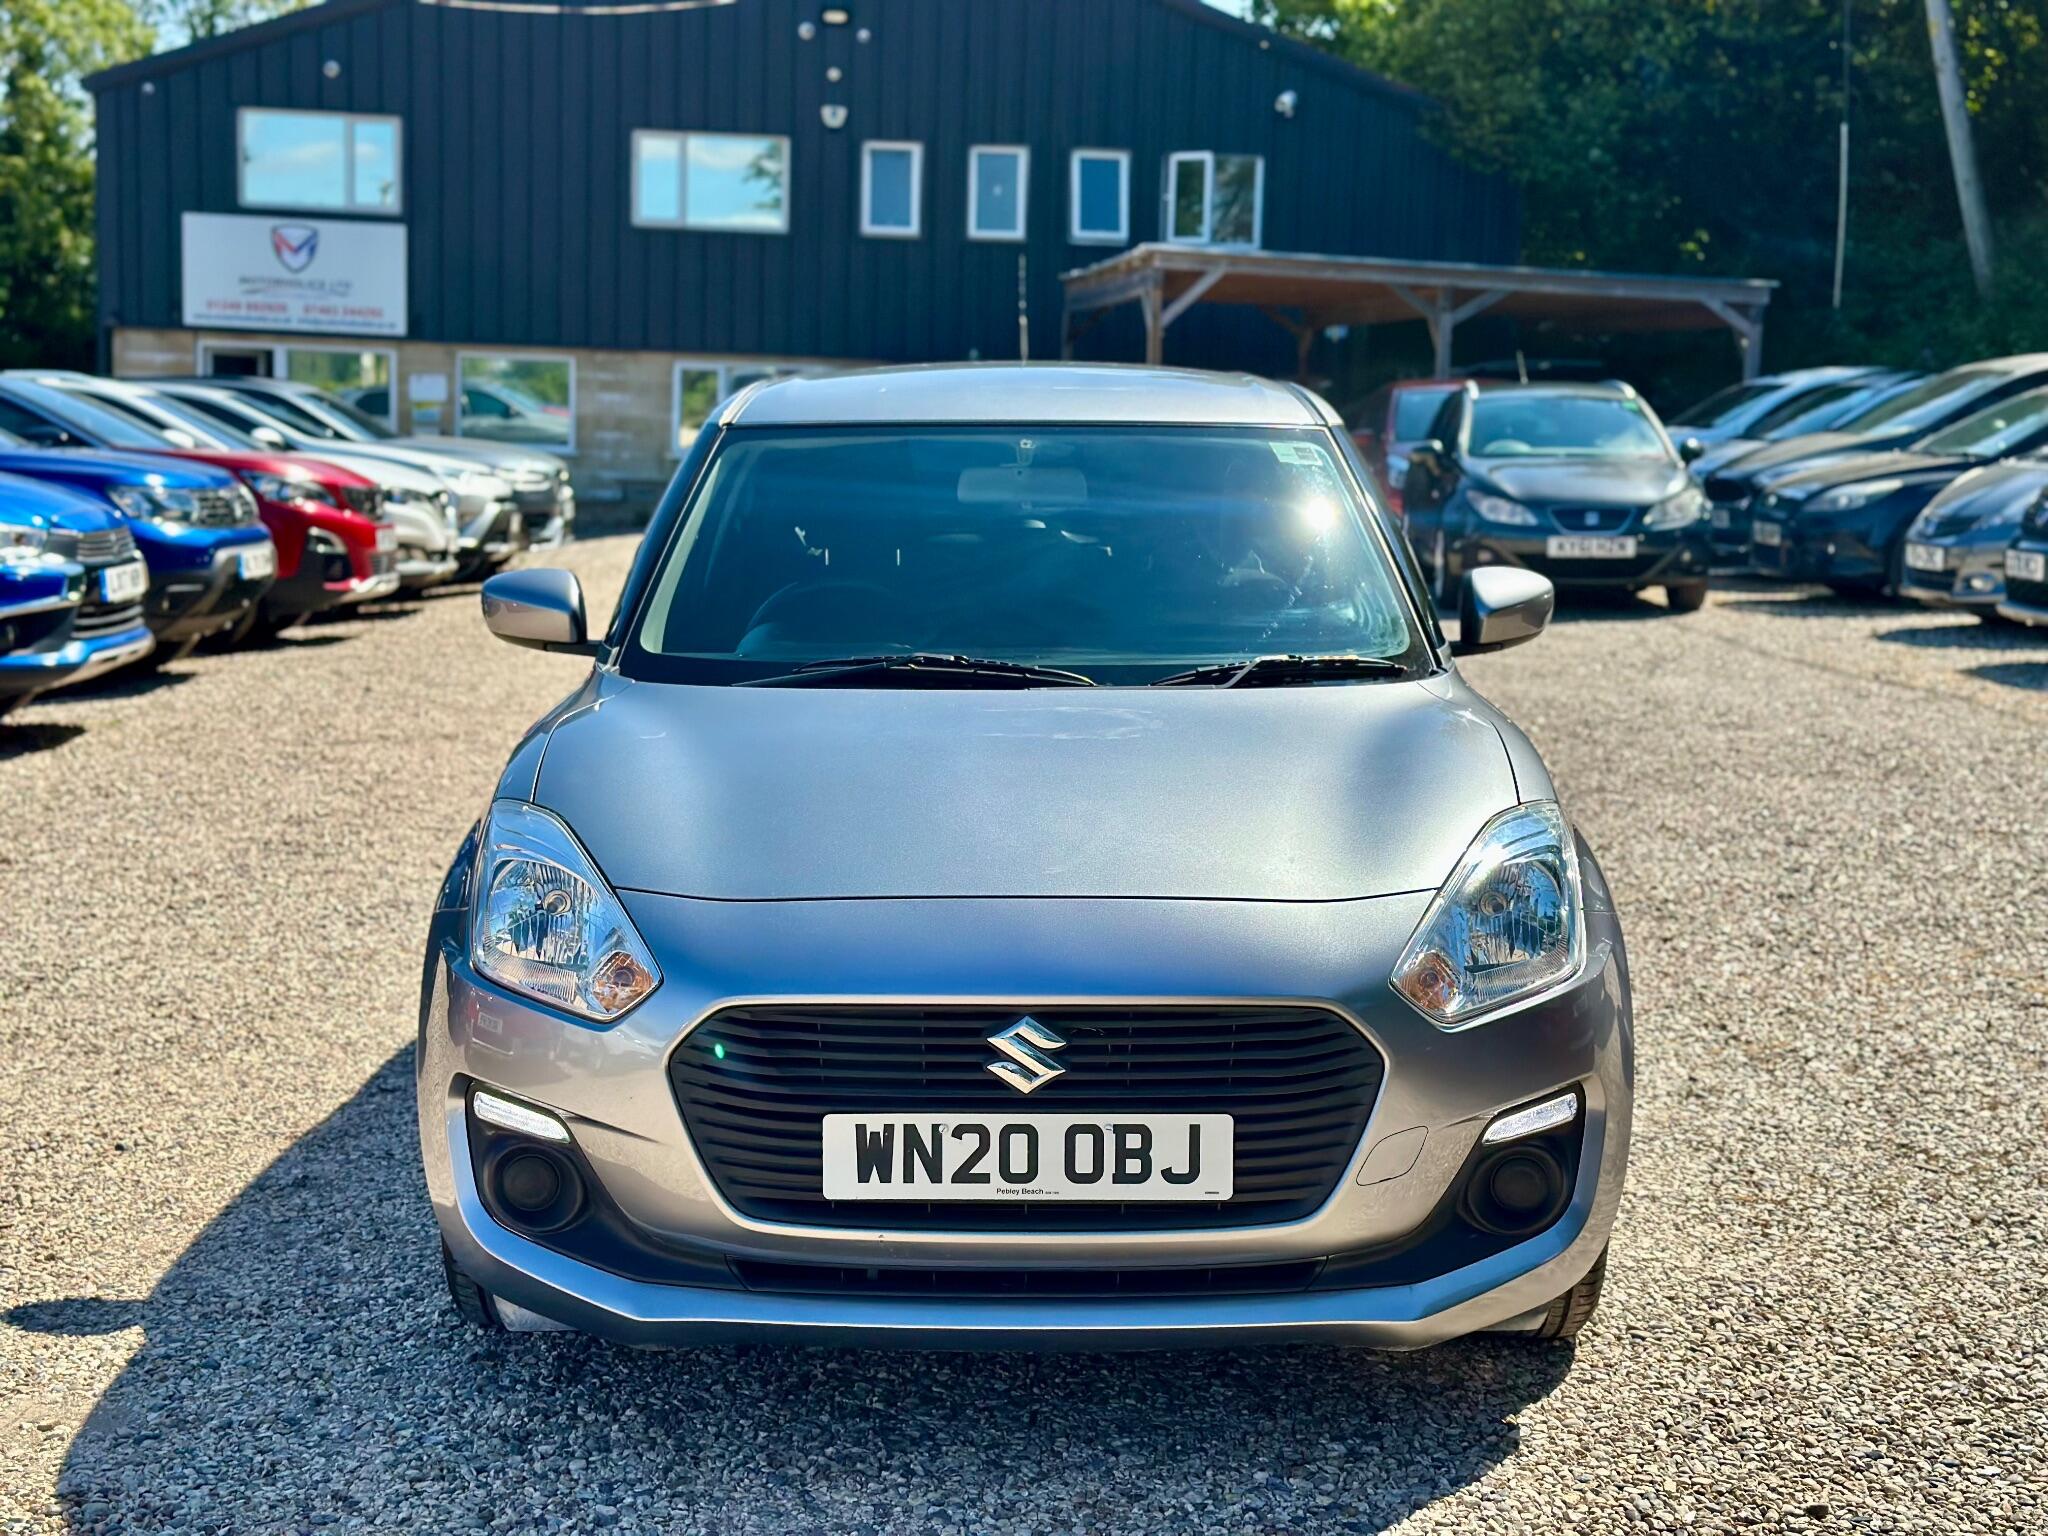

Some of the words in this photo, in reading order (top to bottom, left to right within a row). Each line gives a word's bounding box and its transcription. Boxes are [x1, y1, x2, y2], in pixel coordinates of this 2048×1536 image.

[855, 1123, 1039, 1184] WN20
[1064, 1123, 1201, 1184] OBJ
[996, 1188, 1020, 1196] Pebley
